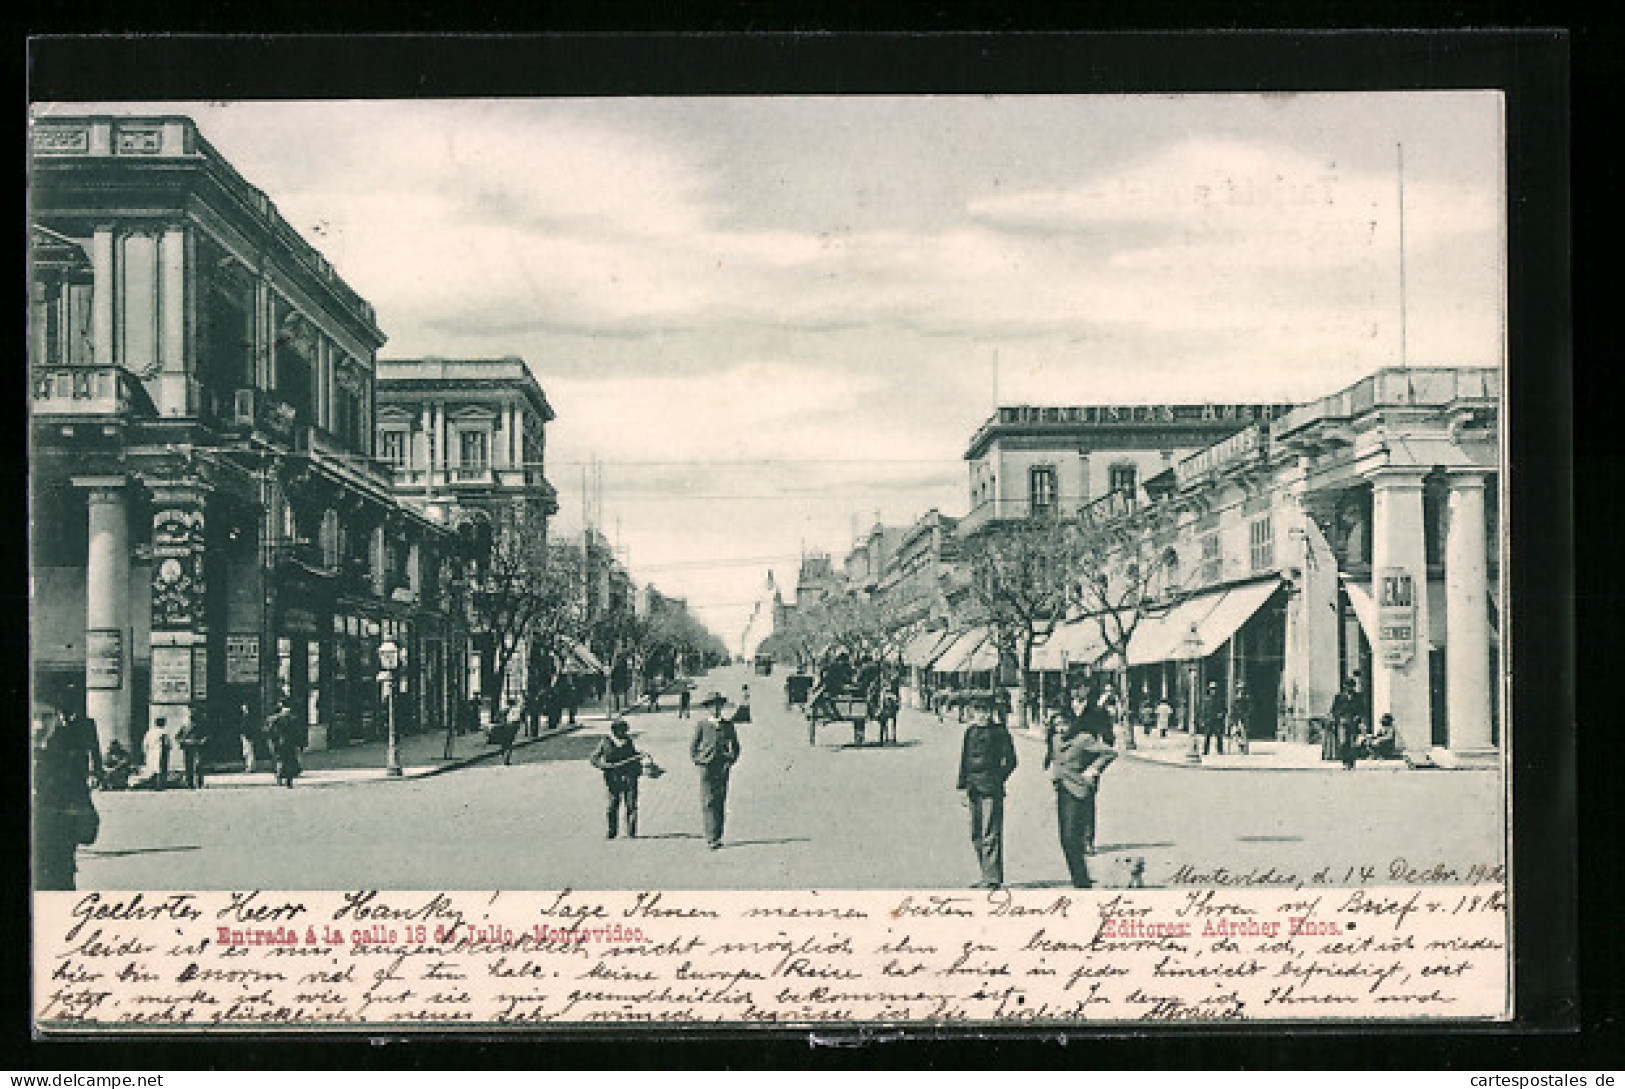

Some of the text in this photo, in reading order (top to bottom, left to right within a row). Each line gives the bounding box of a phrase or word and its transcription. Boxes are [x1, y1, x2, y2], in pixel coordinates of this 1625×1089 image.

[1343, 868, 1375, 883] 14
[217, 890, 306, 922] Herr
[623, 893, 720, 918] Ihnen
[742, 890, 867, 919] meinen
[987, 887, 1069, 918] Dank
[1175, 891, 1259, 918] Ihren
[56, 929, 157, 957] leider
[601, 935, 706, 957] nicht
[711, 931, 853, 977] möglich
[1210, 938, 1240, 954] da
[1262, 985, 1359, 1005] Ihnen
